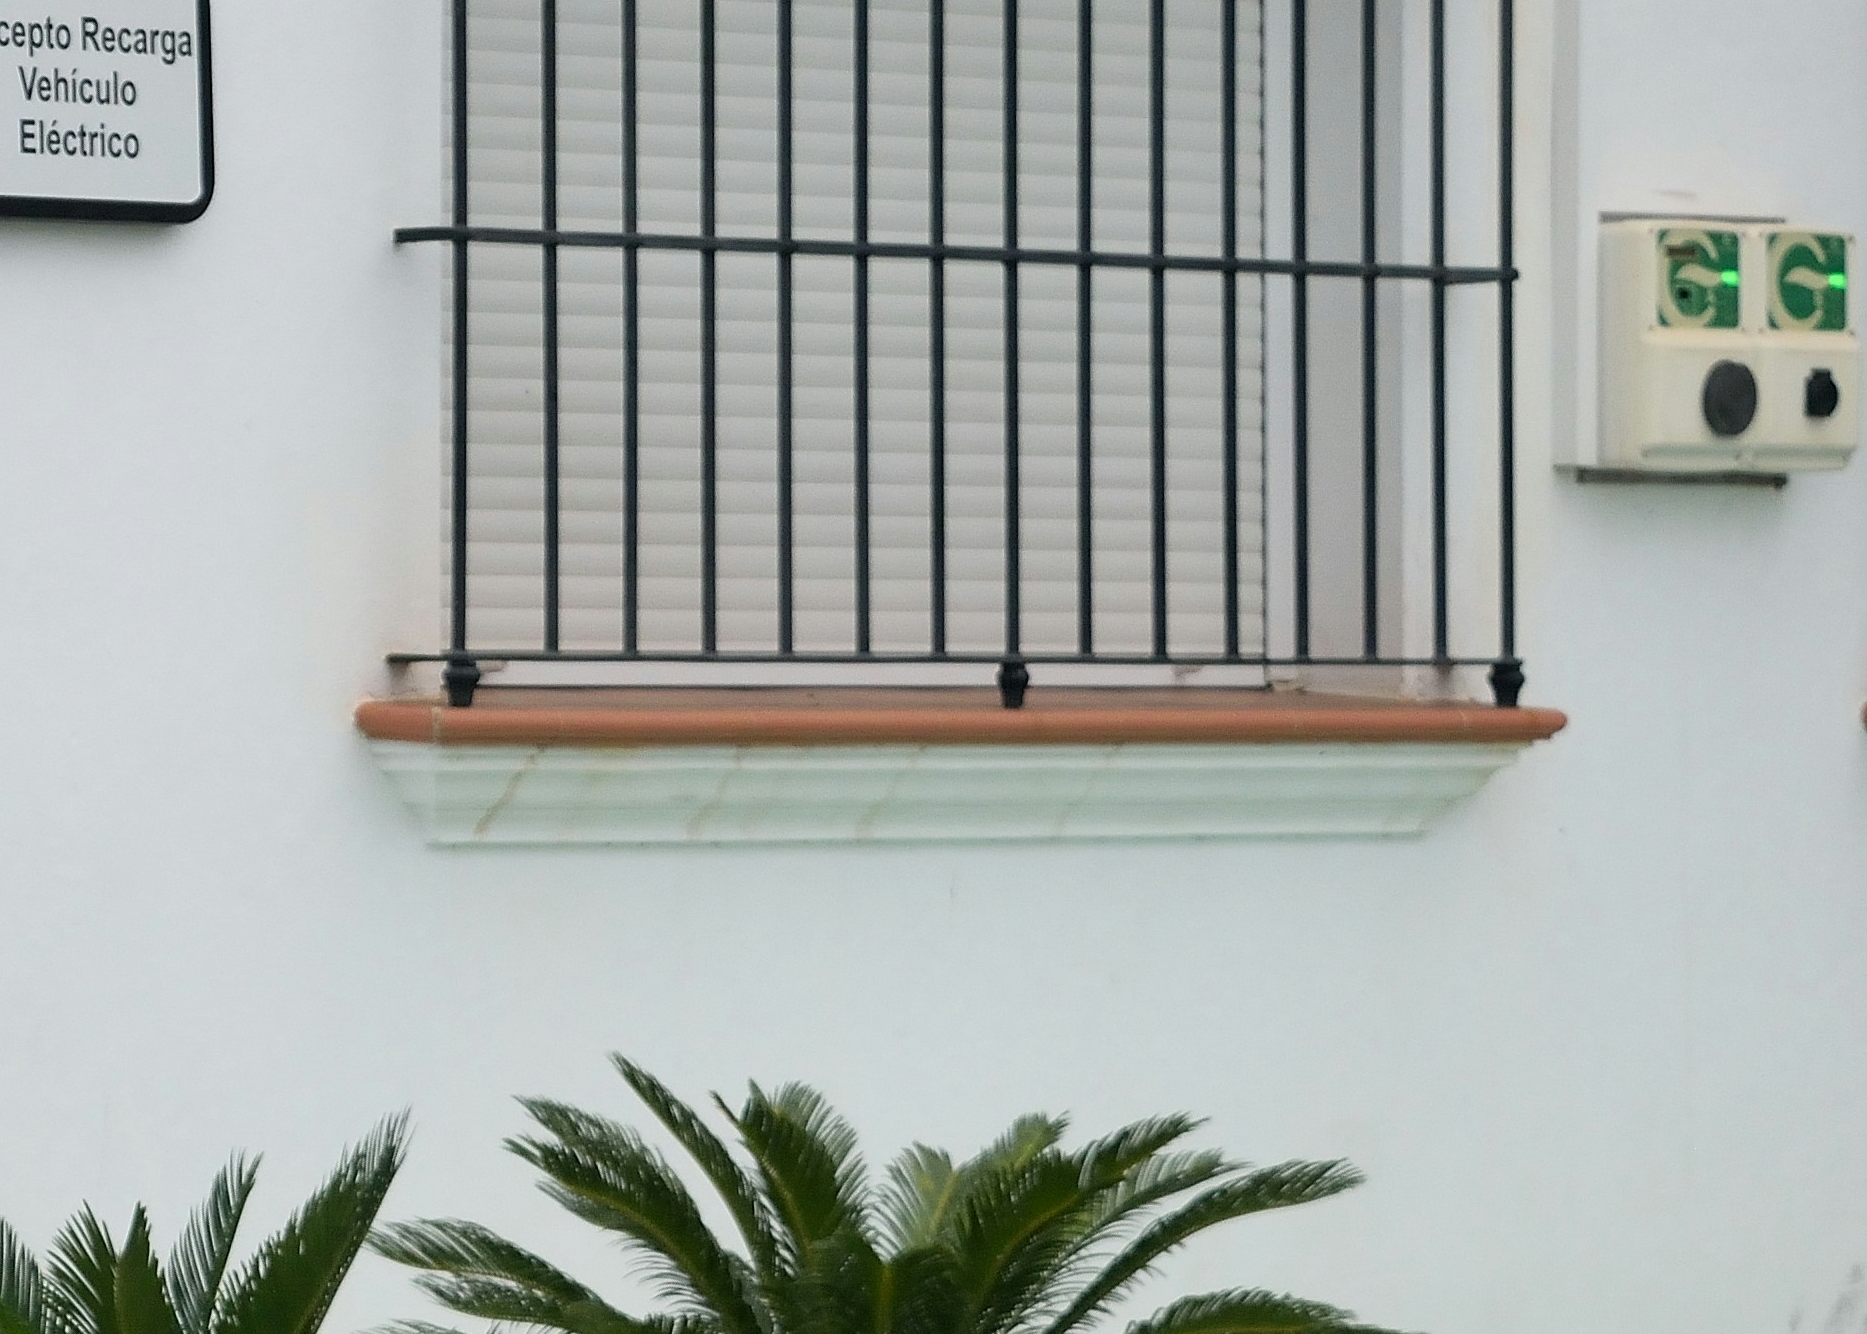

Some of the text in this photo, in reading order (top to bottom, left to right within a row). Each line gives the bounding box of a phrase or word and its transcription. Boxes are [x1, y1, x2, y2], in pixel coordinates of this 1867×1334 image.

[81, 16, 193, 65] Recarga
[17, 65, 137, 106] Vehículo
[19, 118, 139, 159] Eléctrico
